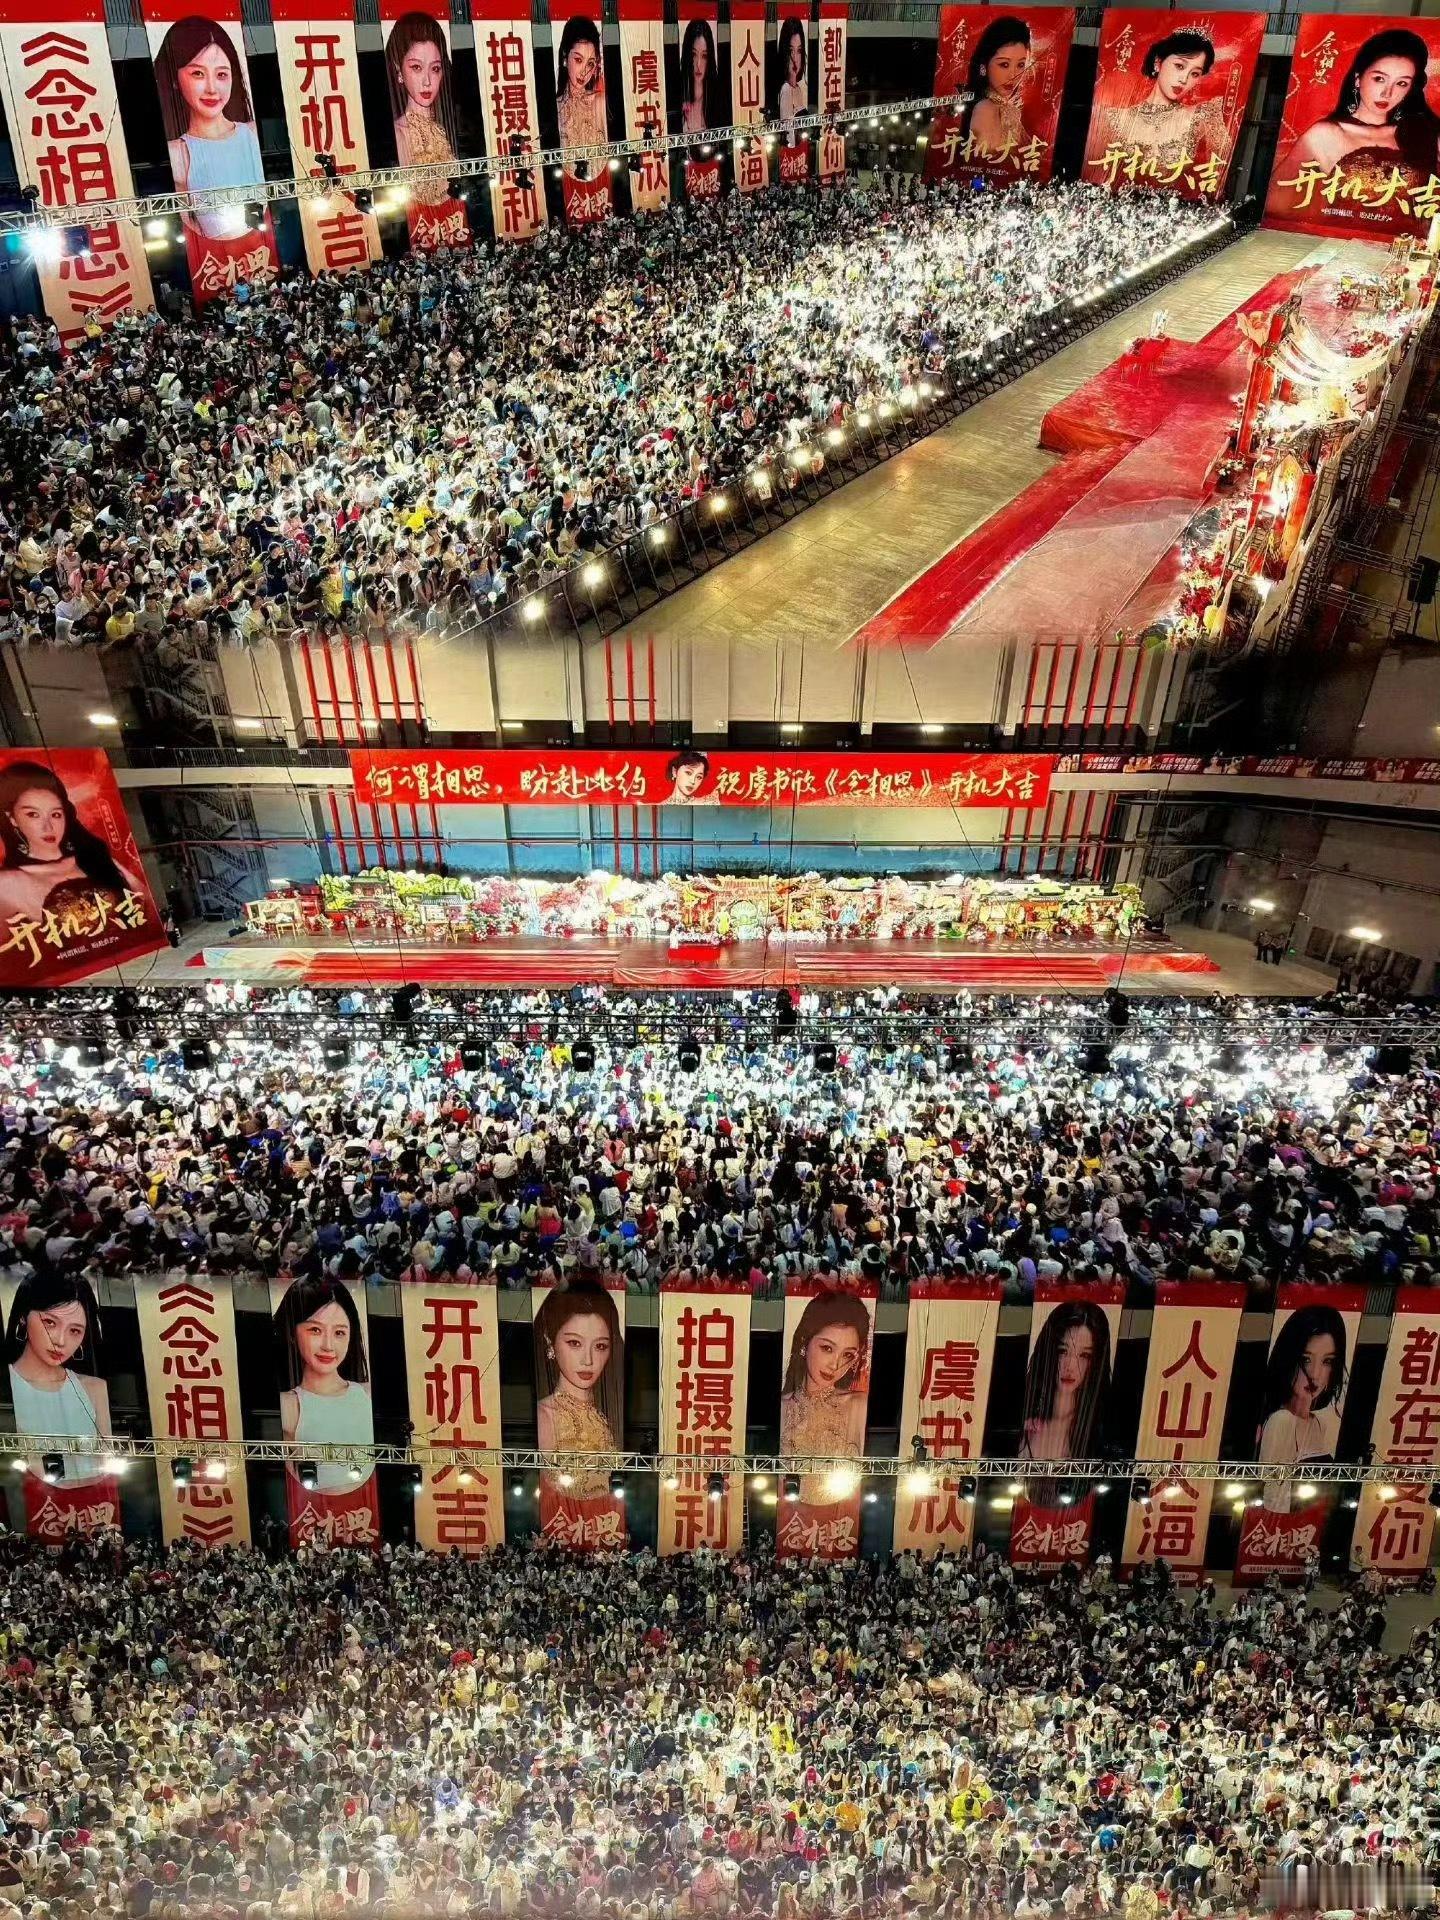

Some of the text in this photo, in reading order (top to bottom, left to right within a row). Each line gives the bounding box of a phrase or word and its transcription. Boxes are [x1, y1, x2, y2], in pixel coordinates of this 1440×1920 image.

[943, 18, 969, 67] 念相思
[1105, 24, 1135, 72] 念相思
[1301, 31, 1338, 84] 念相思
[780, 152, 809, 177] 念相思
[931, 127, 1048, 172] 开机大吉
[1088, 142, 1227, 192] 开机大吉
[566, 188, 614, 219] 念相思
[686, 169, 721, 195] 念相思
[1277, 161, 1440, 218] 开机大吉
[410, 211, 470, 248] 念相思
[0, 888, 147, 968] 开机大吉
[422, 1298, 489, 1545] 开机大吉
[675, 1307, 735, 1549] 拍摄顺利
[908, 1340, 979, 1533] 虞书欣
[1137, 1320, 1217, 1557] 人山人海
[31, 1496, 122, 1537] 念相思
[289, 1500, 378, 1543] 念相思
[542, 1506, 625, 1545] 念相思
[778, 1511, 858, 1553] 念相思
[1011, 1517, 1089, 1555] 念相思
[1240, 1518, 1319, 1558] 念相思
